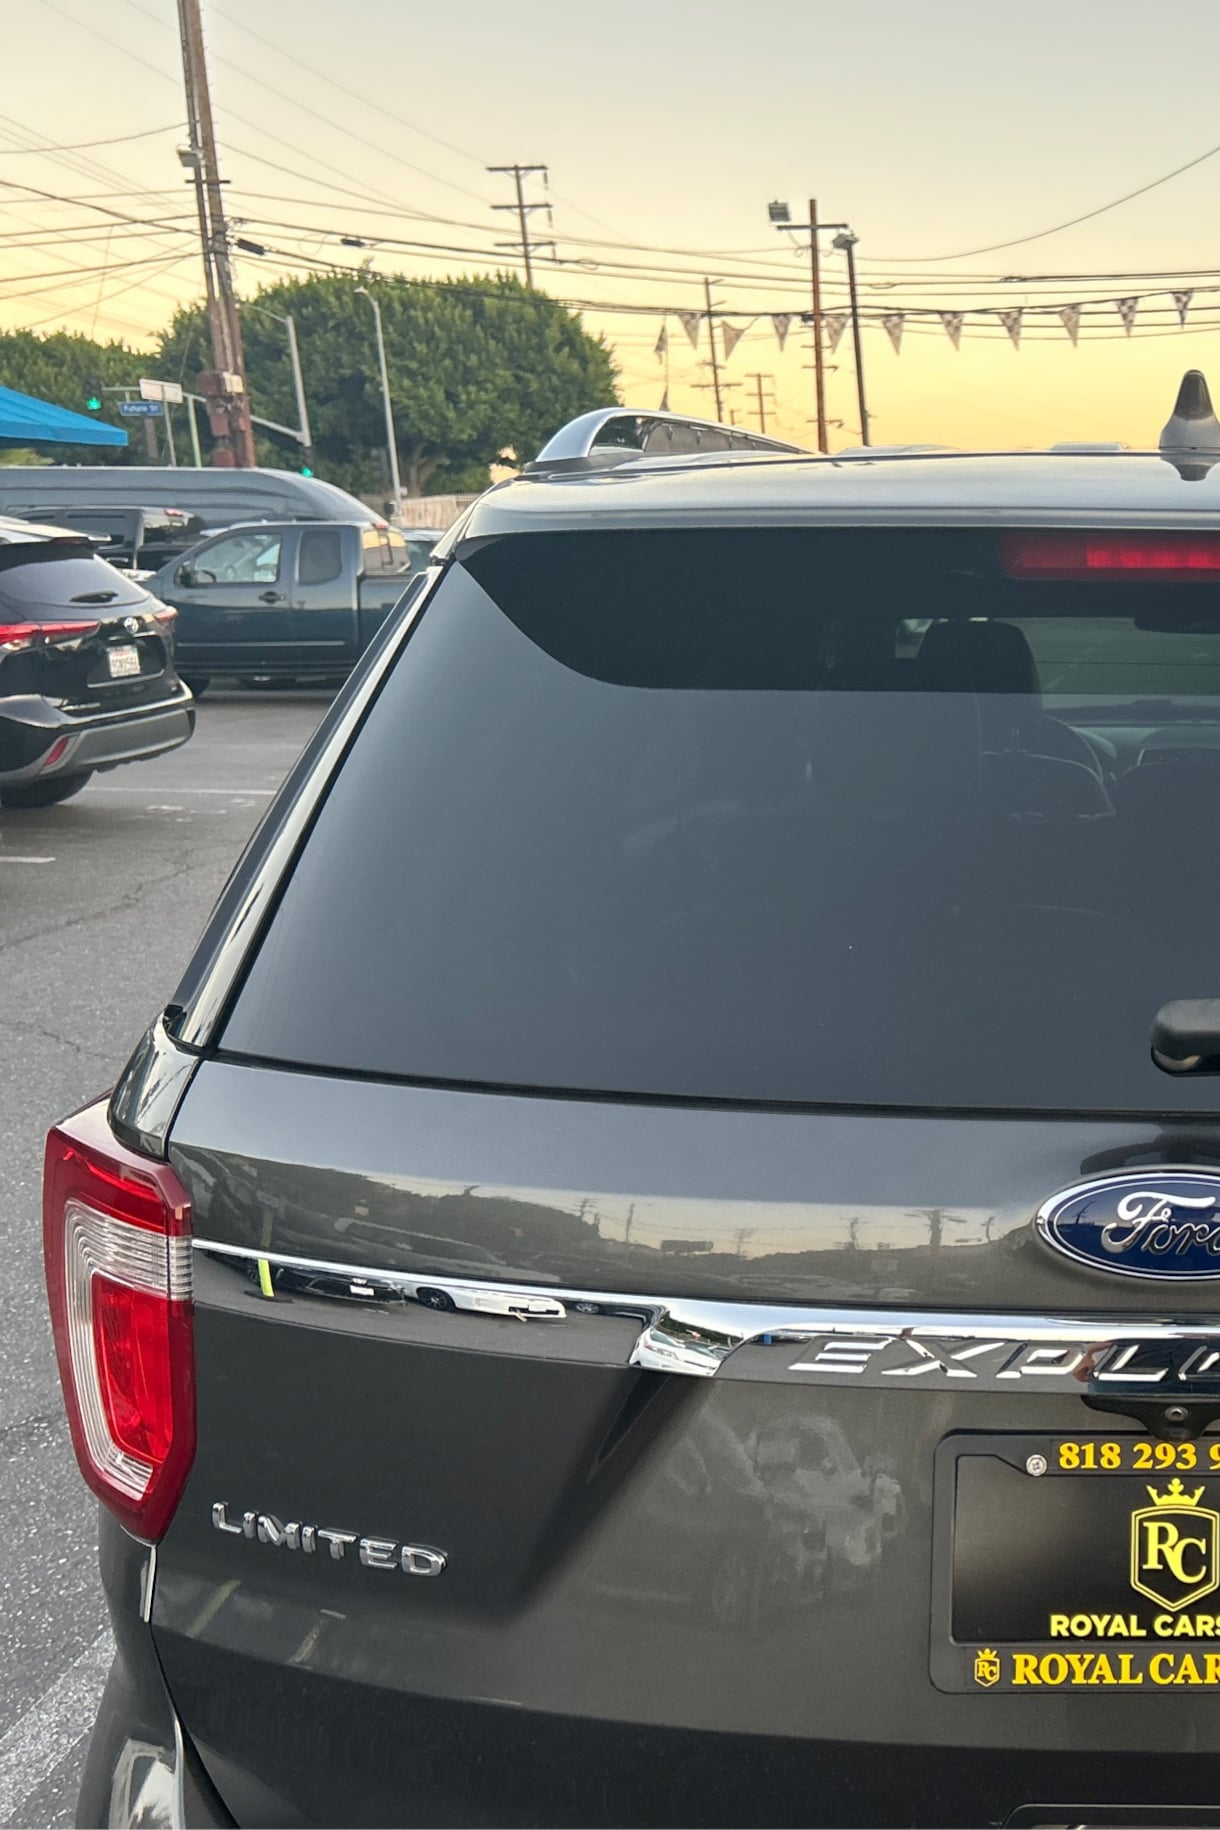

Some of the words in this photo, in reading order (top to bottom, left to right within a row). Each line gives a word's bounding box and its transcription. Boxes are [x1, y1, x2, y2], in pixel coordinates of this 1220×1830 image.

[1059, 1442, 1121, 1469] 818
[1132, 1443, 1197, 1470] 293
[211, 1502, 448, 1577] LIMITED
[1143, 1521, 1207, 1584] RC
[1050, 1614, 1146, 1637] ROYAL
[1012, 1652, 1143, 1685] ROYAL
